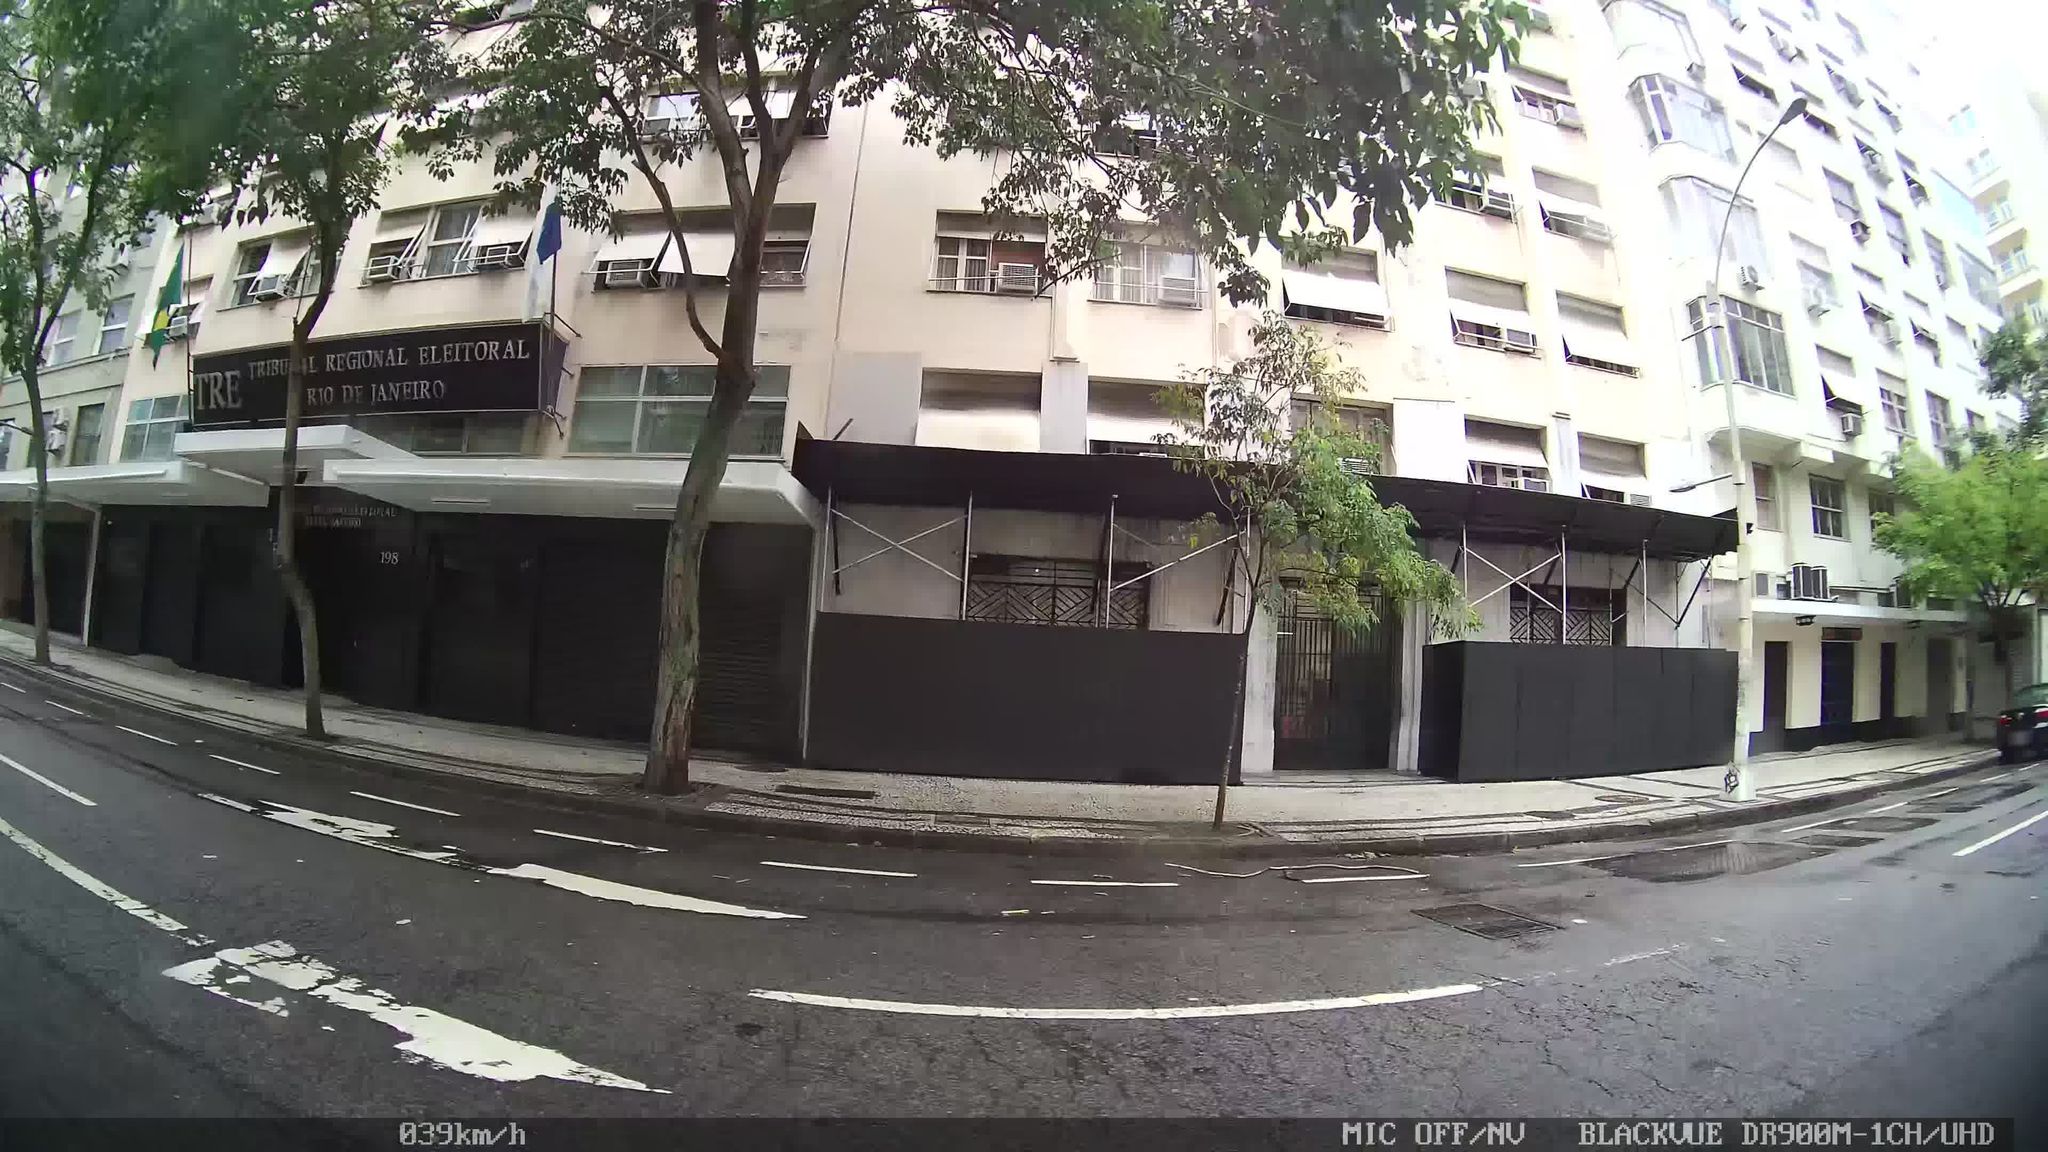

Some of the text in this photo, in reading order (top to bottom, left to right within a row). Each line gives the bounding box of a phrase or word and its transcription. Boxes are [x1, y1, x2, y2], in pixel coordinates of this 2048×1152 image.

[248, 339, 530, 381] TRIBUL REGIONAL ELEITORAL
[194, 370, 242, 410] TRE
[307, 380, 446, 406] RIO DE JANEIRO
[380, 551, 399, 565] 198
